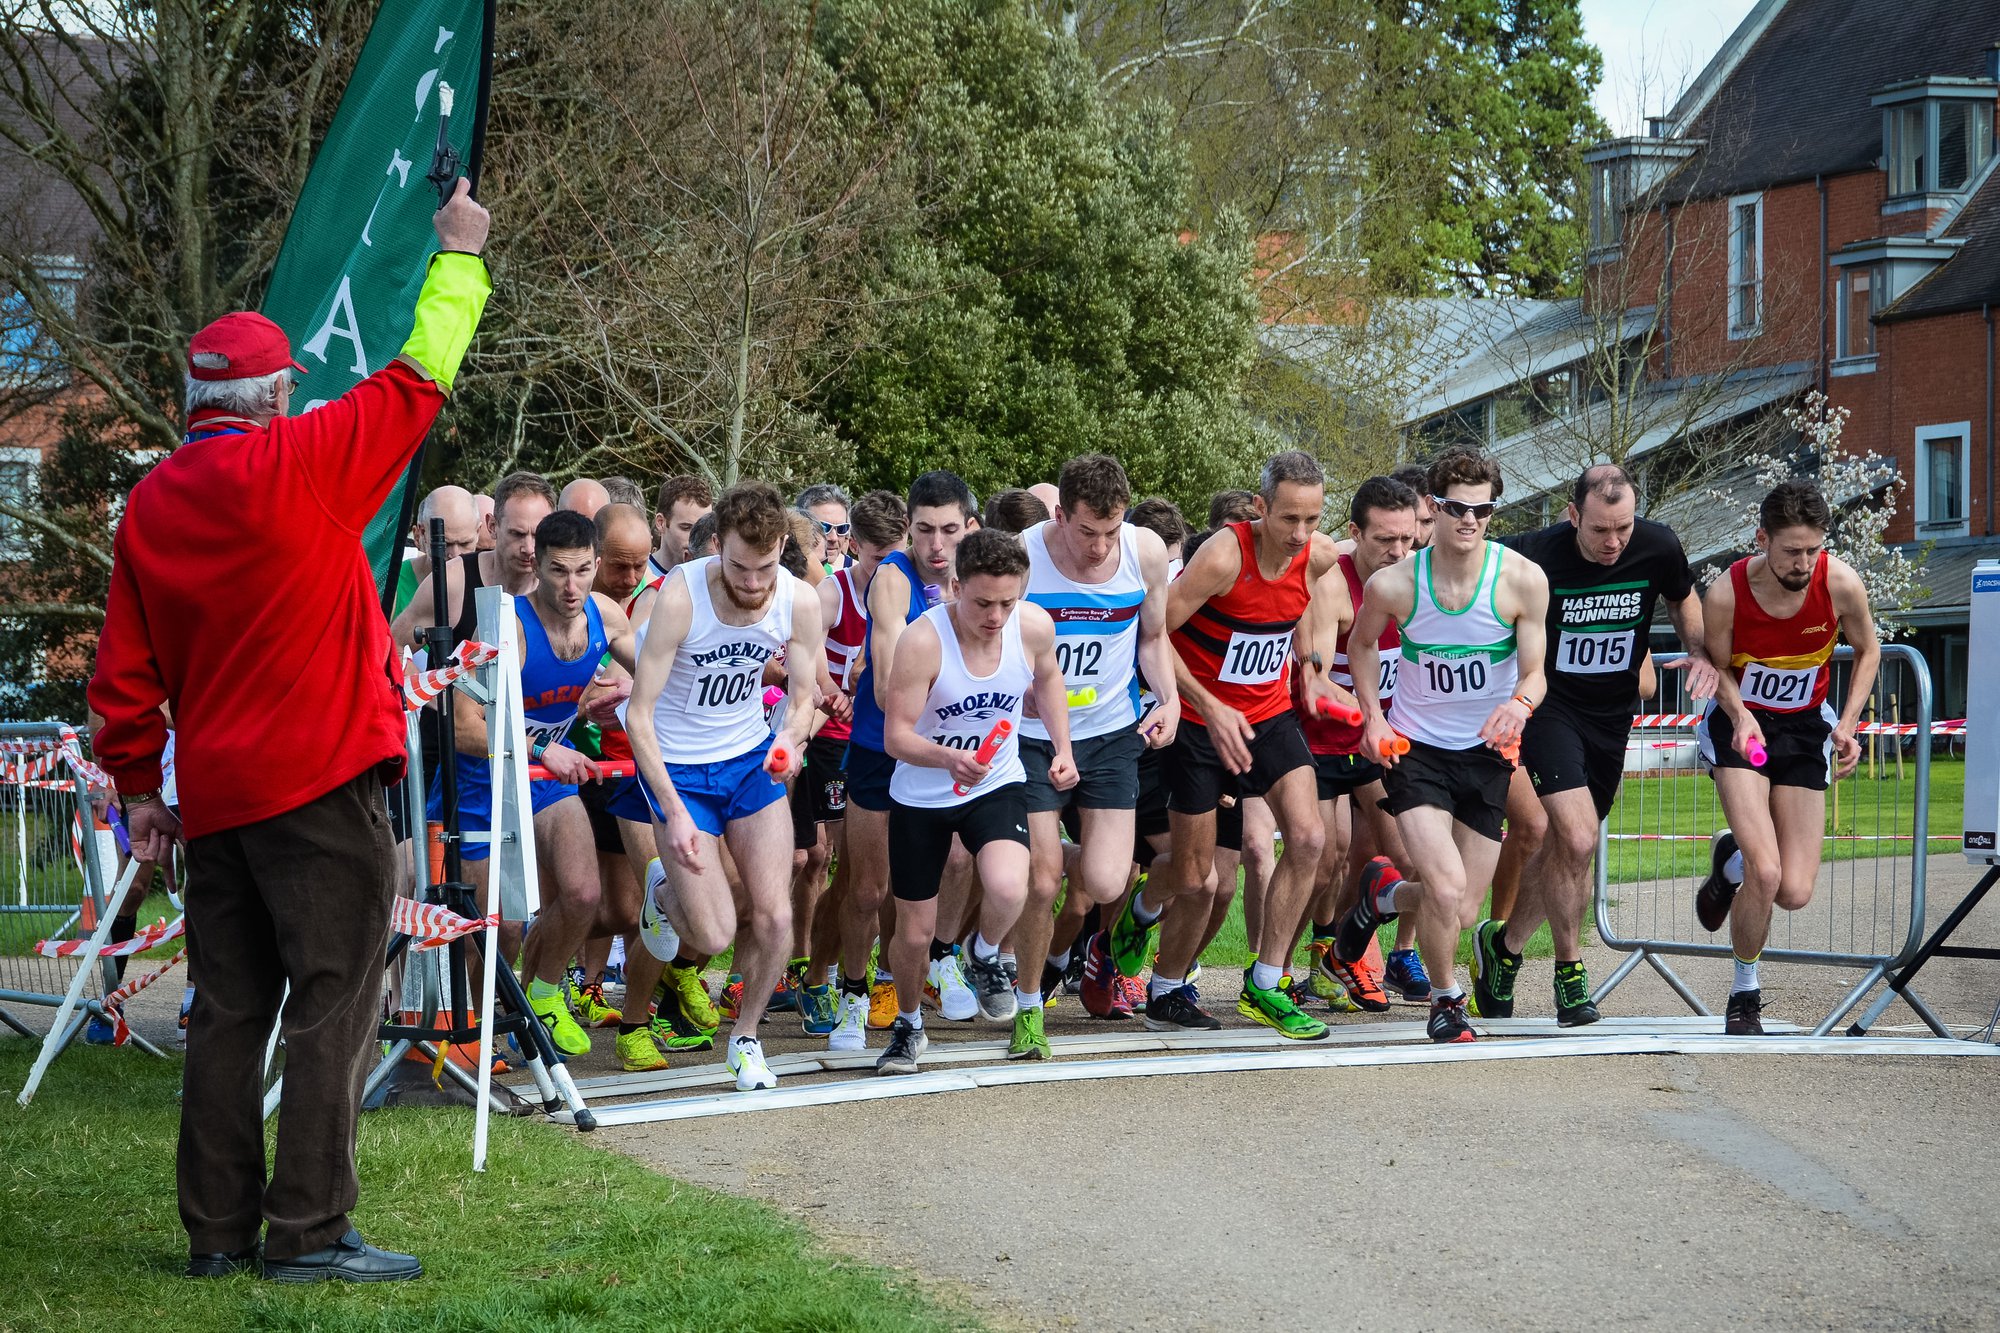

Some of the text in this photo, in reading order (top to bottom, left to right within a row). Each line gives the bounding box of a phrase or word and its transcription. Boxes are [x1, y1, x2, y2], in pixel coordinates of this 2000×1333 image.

[1562, 592, 1641, 611] HASTINGS
[1562, 605, 1640, 623] RUNNERS
[690, 641, 774, 667] PHOENIX
[1056, 641, 1102, 677] 012
[1230, 636, 1288, 676] 1003
[1565, 636, 1626, 666] 1015
[698, 668, 760, 707] 1005
[1378, 658, 1399, 691] 03
[1424, 660, 1486, 693] 1010
[1750, 670, 1811, 702] 1021
[931, 734, 985, 751] 100
